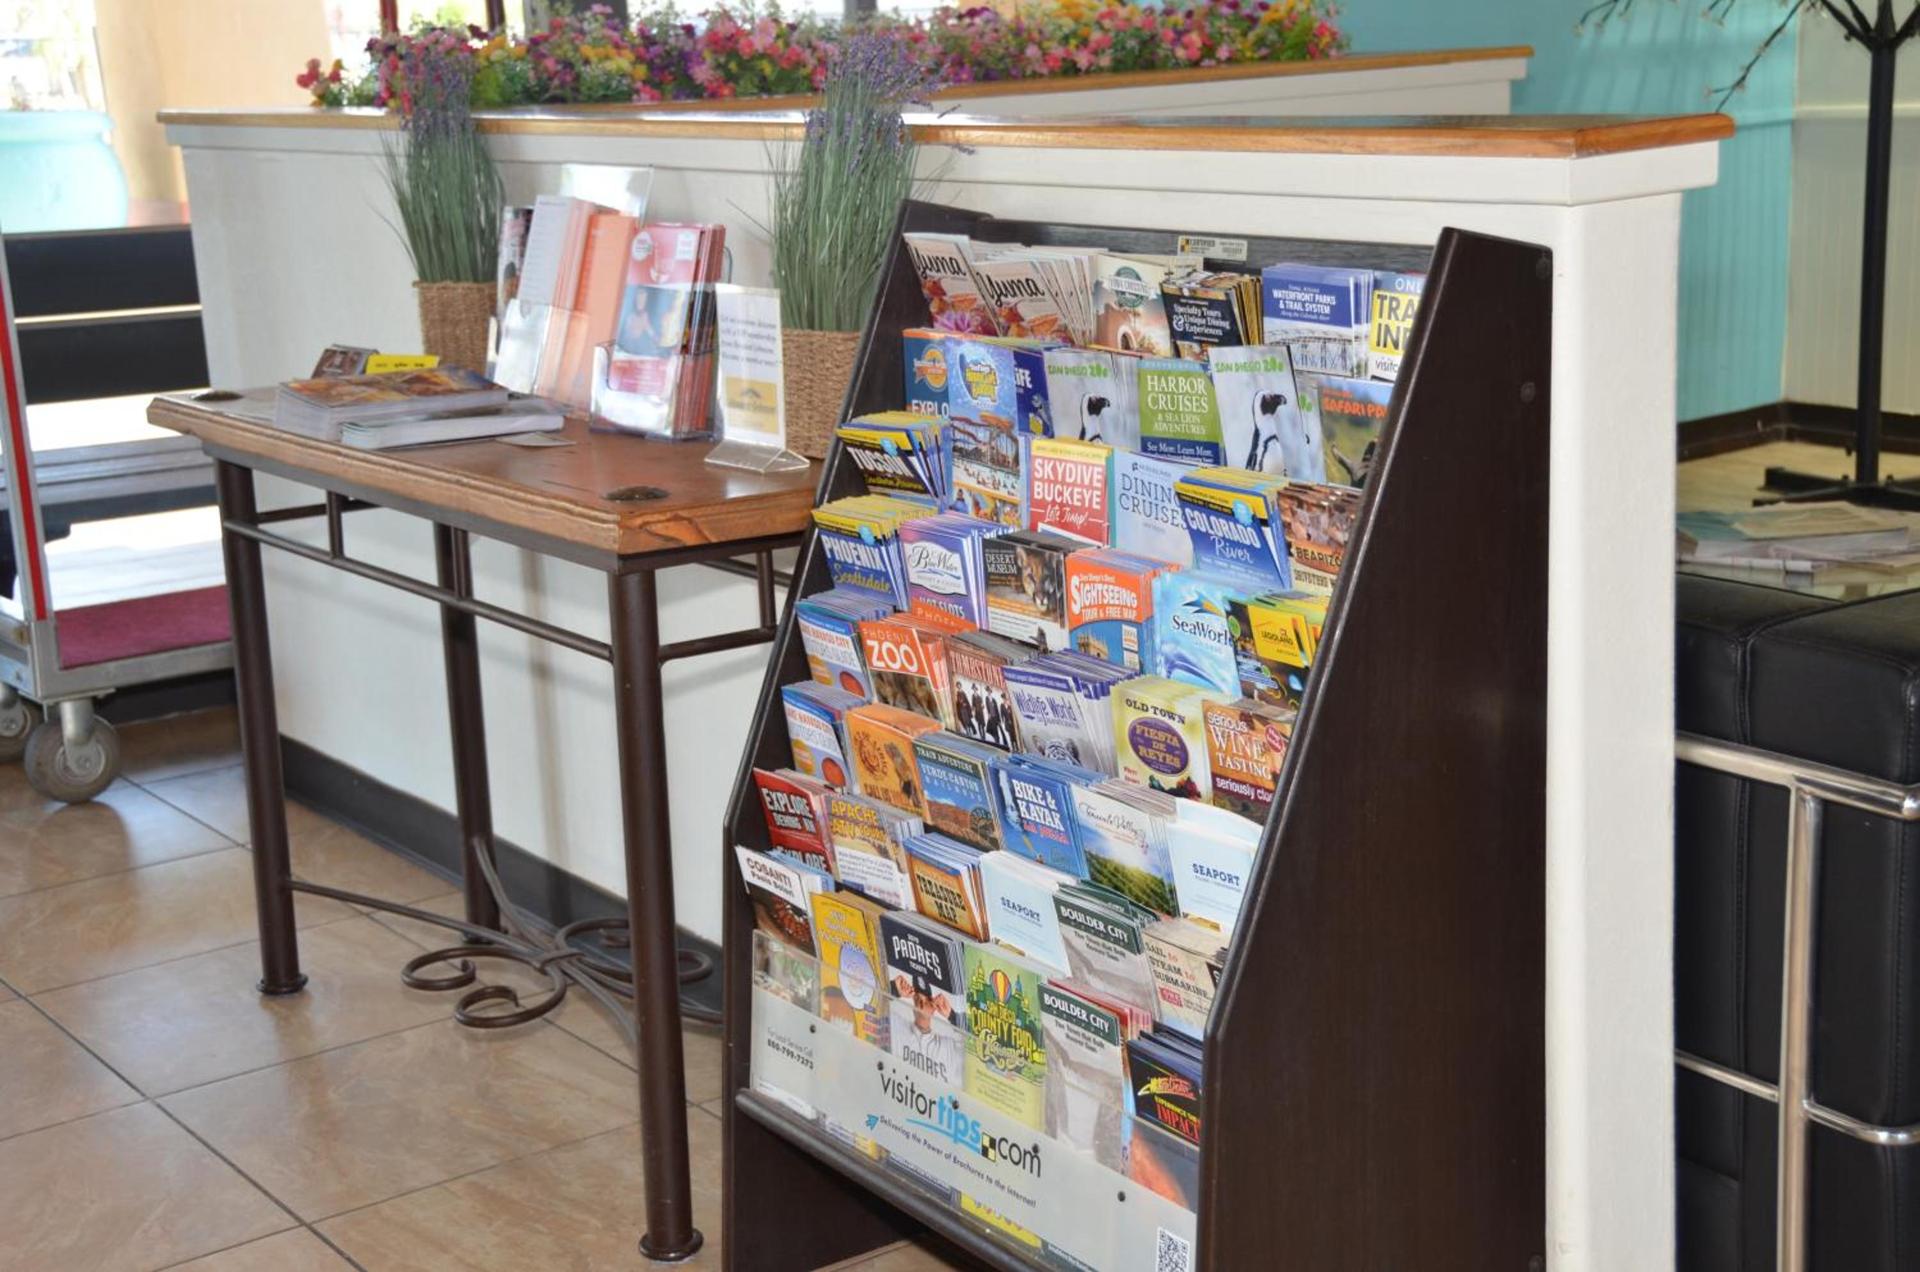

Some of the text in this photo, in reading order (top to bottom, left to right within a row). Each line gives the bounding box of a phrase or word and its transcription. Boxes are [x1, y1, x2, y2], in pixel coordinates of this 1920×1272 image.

[911, 246, 967, 278] Yuma
[977, 272, 1045, 307] Yuma
[1272, 289, 1336, 306] WATERFRONT PARKS
[1202, 306, 1221, 317] Tours
[1279, 300, 1331, 314] & TRAIL SYSTEM
[1173, 315, 1184, 331] &
[1147, 375, 1208, 395] HARBOR
[1148, 394, 1209, 413] CRUISES
[1153, 422, 1206, 435] ADVENTURES
[846, 446, 914, 478] TUCSON
[1034, 459, 1103, 488] SKYDIVE
[1034, 481, 1101, 509] BUCKEYE
[1184, 508, 1261, 549] COLORADO
[821, 534, 886, 572] PHOENIX
[985, 553, 1015, 564] DESERT
[1210, 535, 1254, 564] River
[1295, 546, 1343, 567] BEARIZO
[987, 564, 1017, 575] MUSEUM
[1071, 575, 1137, 616] SIGHTSEEING
[1082, 608, 1098, 621] TOUR
[1106, 607, 1120, 618] FREE
[1122, 607, 1137, 620] MAP
[866, 639, 918, 673] ZOO
[1125, 698, 1185, 725] OLD TOWN
[1136, 725, 1180, 747] FIESTA
[1210, 724, 1265, 762] WINE
[916, 746, 936, 760] TRAIN
[1138, 745, 1181, 768] REYES
[1216, 753, 1271, 781] TASTING
[921, 763, 979, 793] VERDE CANYON
[1216, 776, 1256, 799] seriously
[1012, 779, 1057, 810] BIKE &
[832, 801, 877, 823] APACHE
[1019, 800, 1065, 831] KAYAK
[747, 858, 792, 889] COSANTI
[1192, 863, 1240, 887] SEAPORT
[916, 874, 967, 911] TREASURE
[934, 901, 958, 925] MAP
[1001, 897, 1041, 922] SEAPORT
[1060, 905, 1107, 933] BOULDER
[1107, 925, 1129, 944] CITY
[892, 935, 942, 981] PADRES
[972, 1006, 1009, 1042] COUNTY
[1044, 993, 1109, 1033] BOULDER CITY
[1157, 1103, 1199, 1140] IMPACT
[880, 1115, 911, 1139] Delivering
[912, 1133, 921, 1144] the
[923, 1138, 943, 1155] Power
[944, 1150, 951, 1159] of
[953, 1155, 984, 1179] Brochures
[986, 1174, 993, 1185] to
